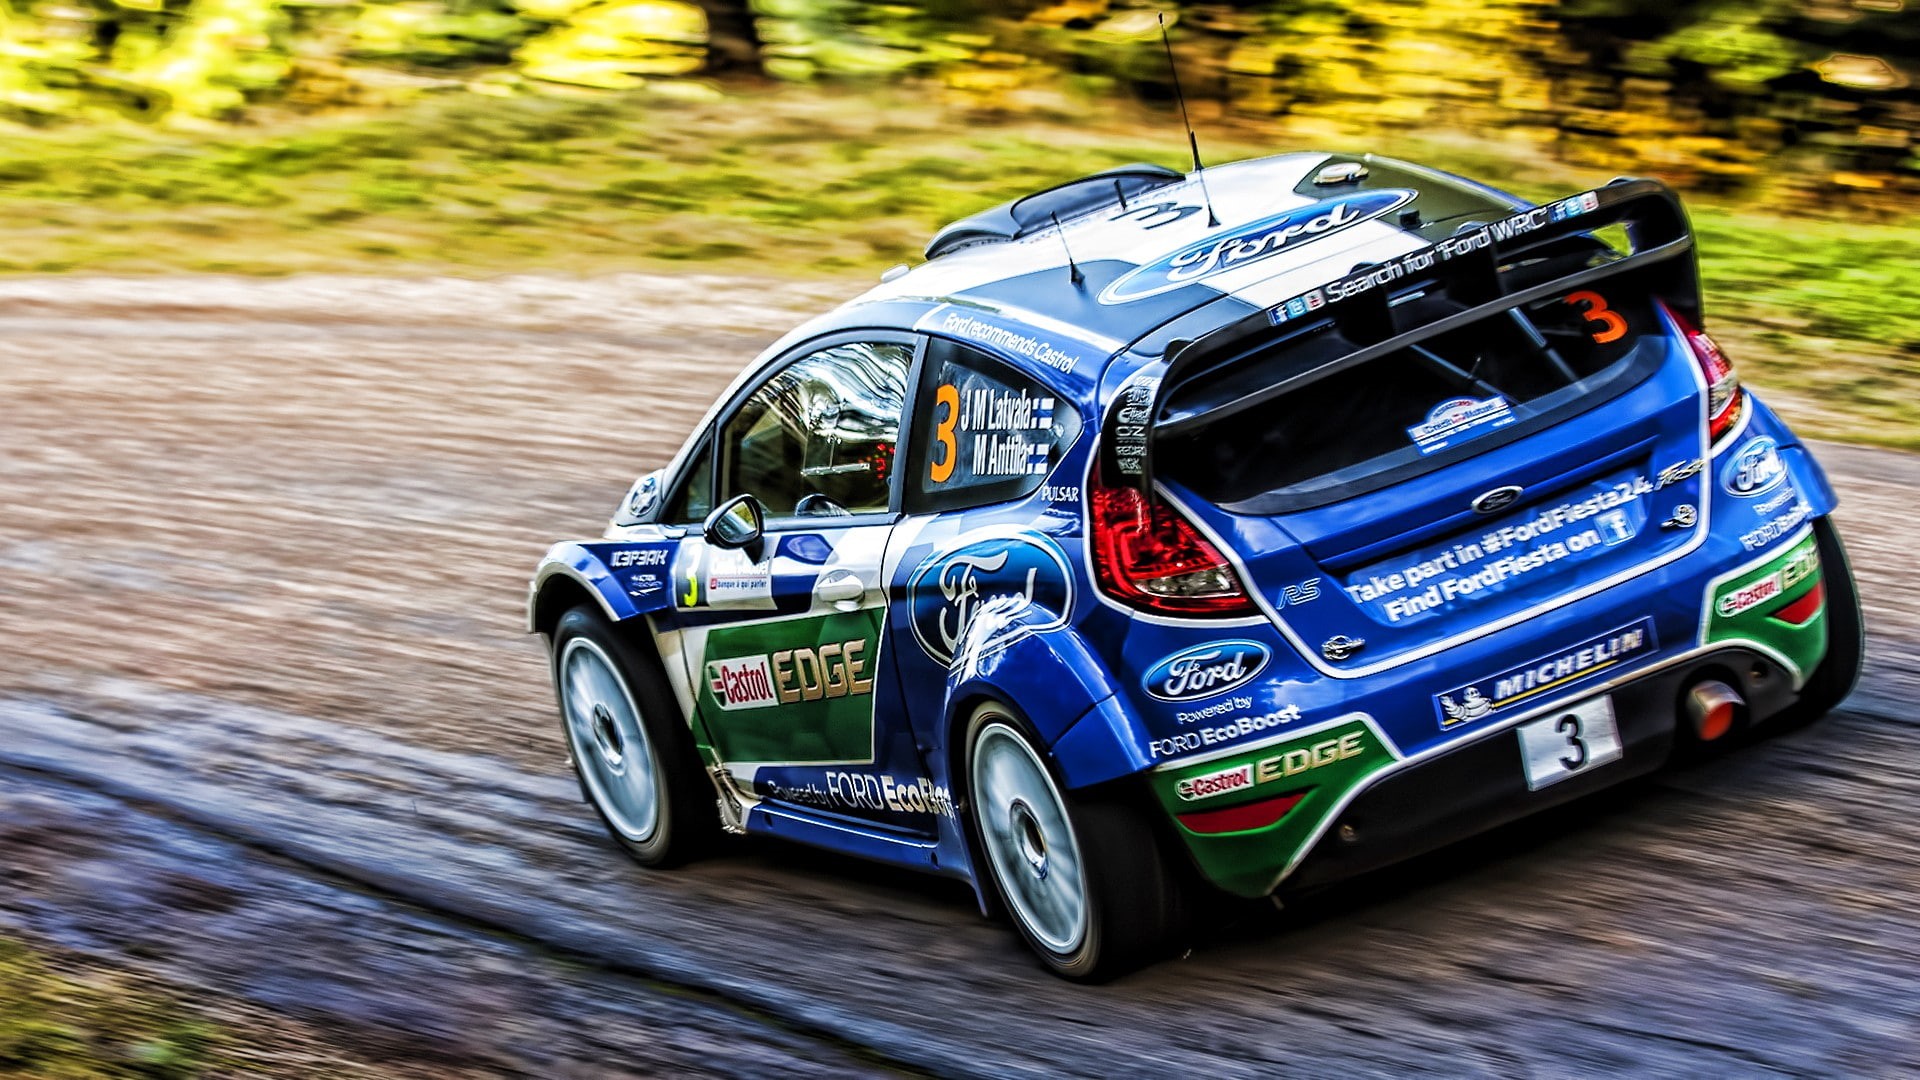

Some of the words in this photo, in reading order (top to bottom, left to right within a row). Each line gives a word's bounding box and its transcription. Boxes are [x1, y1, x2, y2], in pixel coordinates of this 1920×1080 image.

[1107, 202, 1202, 230] 3
[1167, 204, 1360, 281] Ford
[1325, 262, 1403, 302] Search
[1401, 253, 1435, 274] for
[943, 312, 973, 334] Ford
[968, 319, 1038, 356] recommends
[1034, 342, 1079, 374] Castrol
[1563, 290, 1628, 344] 3
[930, 383, 960, 483] 3
[961, 389, 971, 431] J
[972, 389, 987, 430] M
[988, 388, 1031, 430] Latvala
[972, 434, 988, 475] M
[988, 433, 1027, 475] Anttila
[1041, 486, 1079, 502] PULSAR
[1344, 573, 1406, 604] Take
[1402, 550, 1458, 588] part
[1453, 544, 1485, 564] in
[1480, 475, 1654, 554] #FordFiesta24
[1276, 578, 1321, 609] RS
[1383, 584, 1444, 622] Find
[1439, 526, 1570, 600] FordFiesta
[1566, 527, 1601, 553] on
[721, 660, 774, 705] Castrol
[772, 638, 873, 705] EDGE
[1164, 650, 1247, 696] Ford
[1494, 628, 1643, 700] MICHELIN
[1148, 732, 1201, 759] FORD
[1200, 703, 1302, 747] EcoBoost
[1177, 698, 1234, 724] Powered
[1231, 695, 1252, 710] by
[1193, 768, 1249, 796] Castrol
[1256, 730, 1365, 784] EDGE
[1555, 713, 1589, 772] 3
[825, 771, 885, 810] FORD
